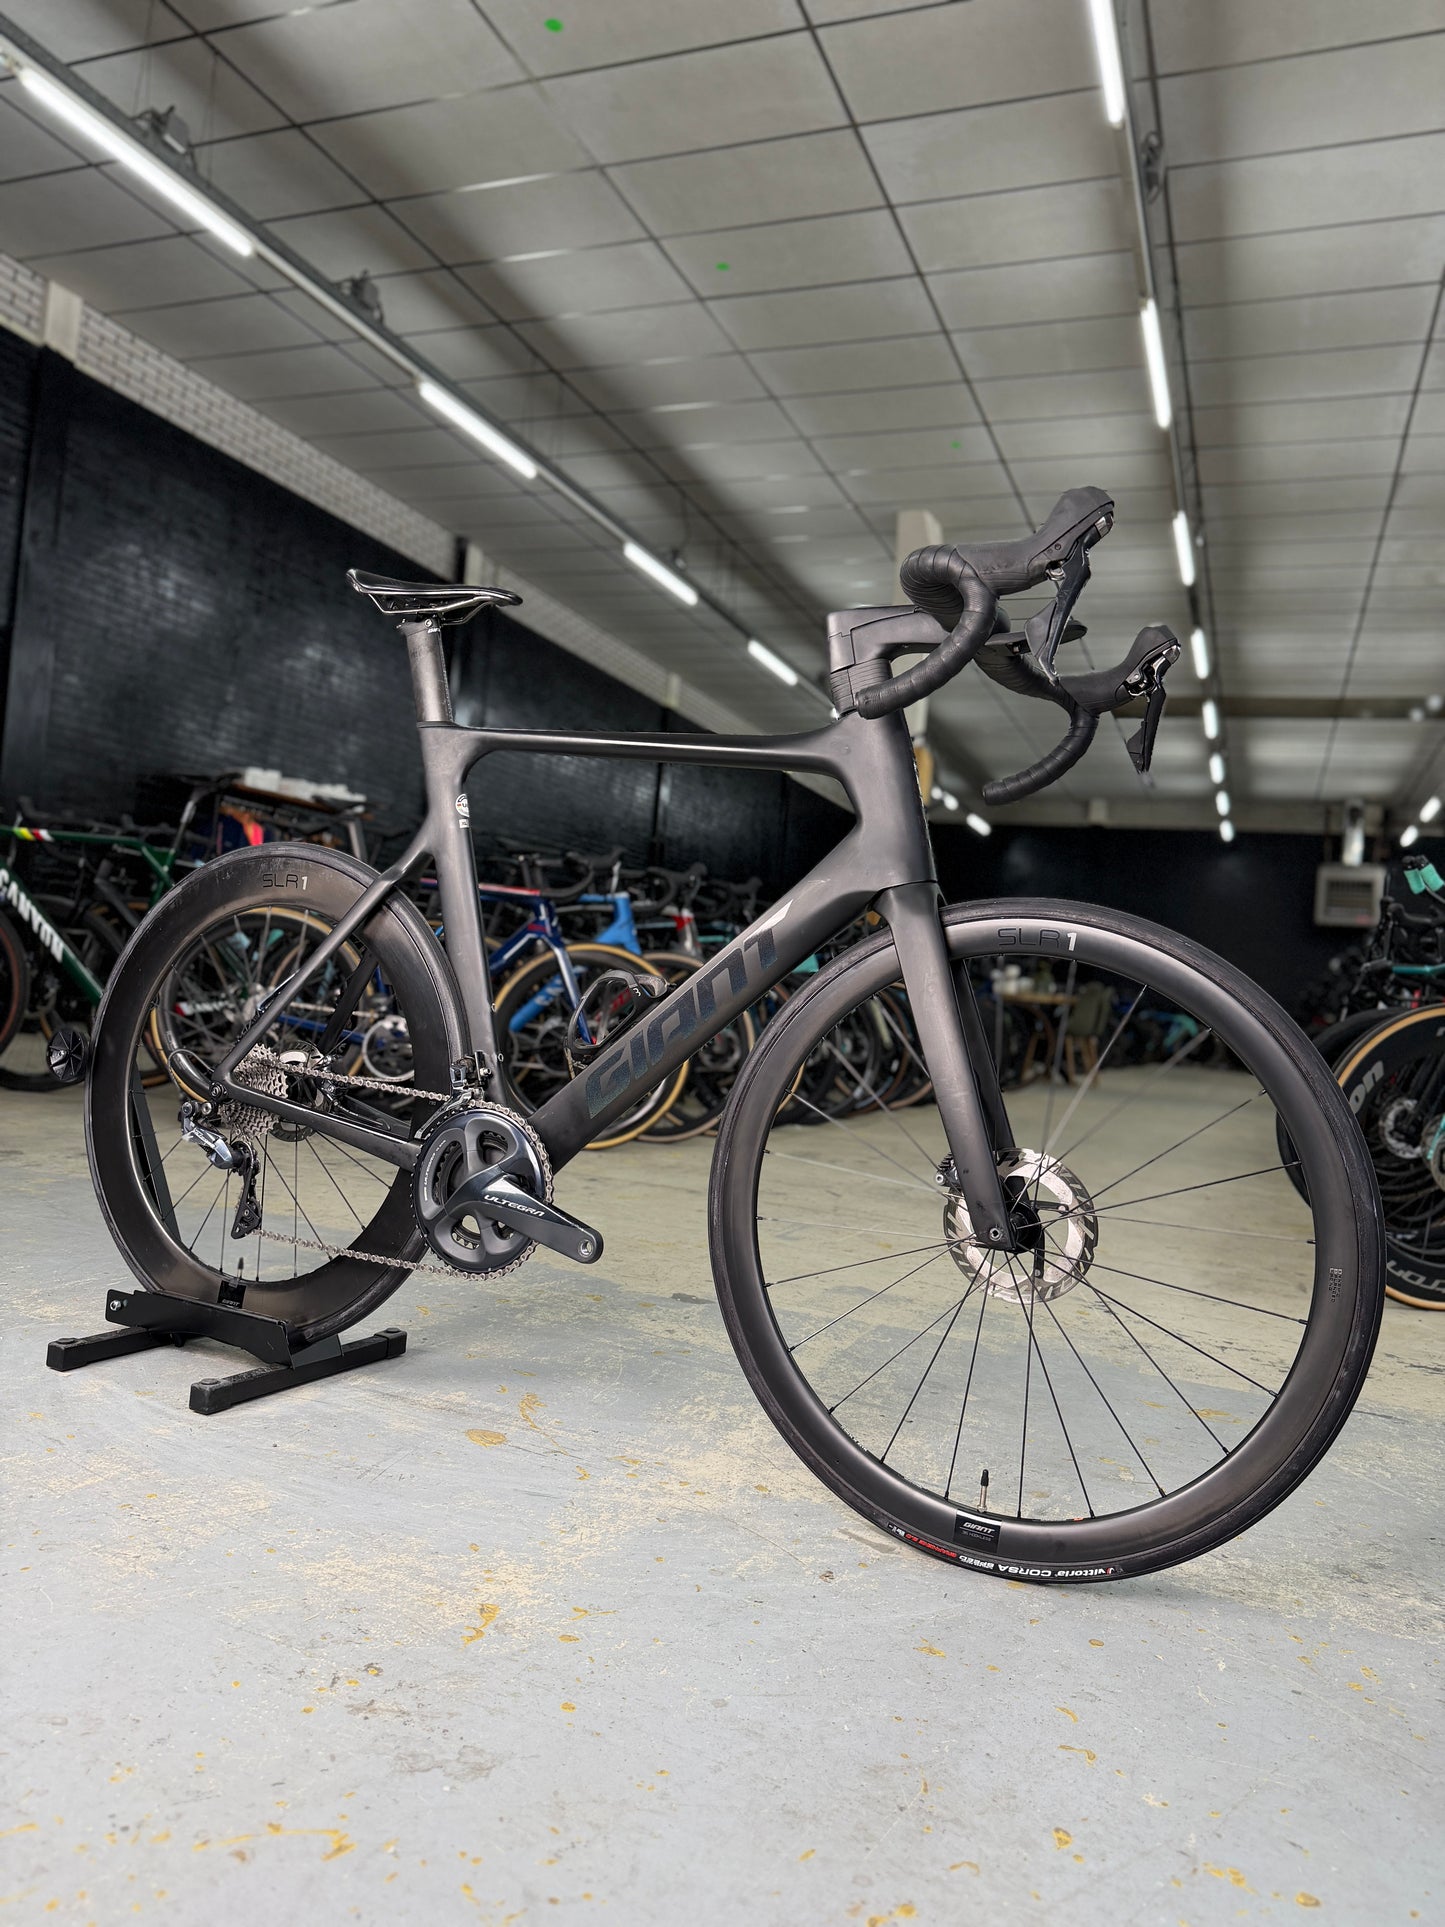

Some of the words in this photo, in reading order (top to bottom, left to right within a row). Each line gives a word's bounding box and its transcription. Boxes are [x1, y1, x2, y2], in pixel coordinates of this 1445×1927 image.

[585, 899, 794, 1119] GIANT
[484, 1194, 545, 1217] ULTEGRA
[962, 1521, 996, 1534] GIANT
[999, 1564, 1051, 1577] CORSA
[1055, 1567, 1107, 1577] vittoria
